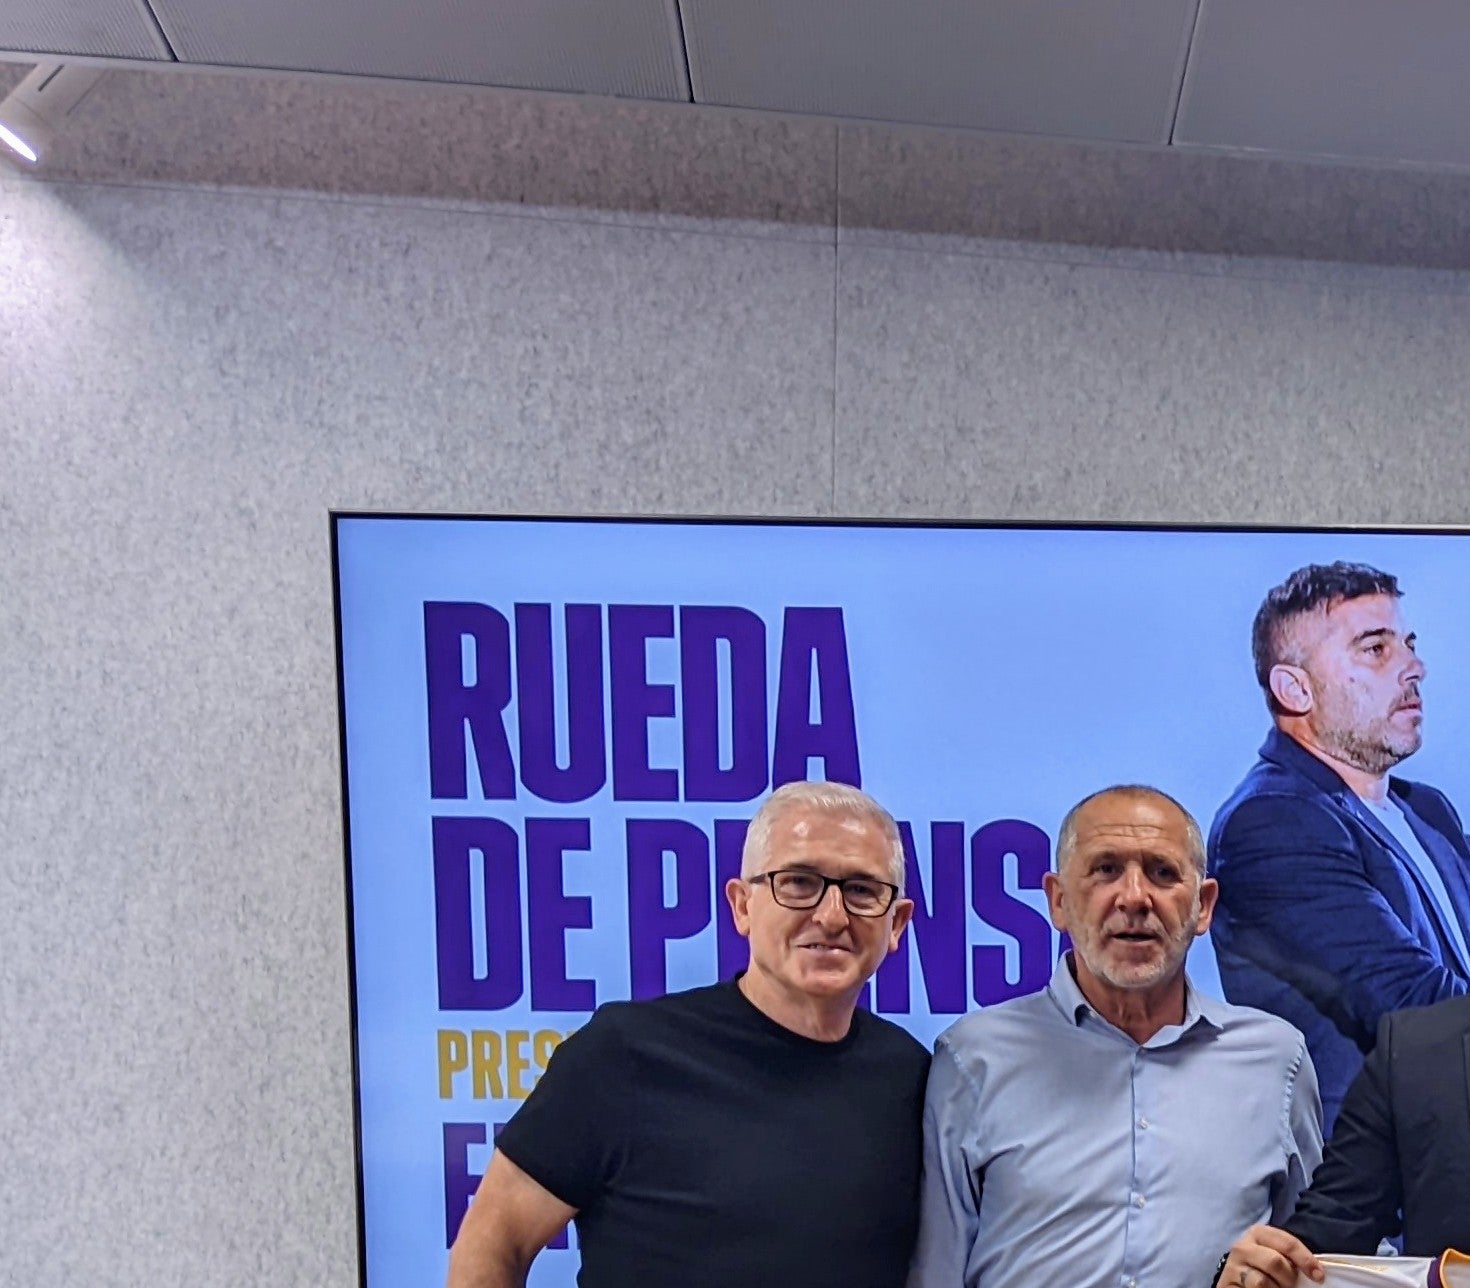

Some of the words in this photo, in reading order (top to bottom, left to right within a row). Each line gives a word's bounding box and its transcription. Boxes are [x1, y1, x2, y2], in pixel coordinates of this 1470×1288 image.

[423, 600, 862, 803] RUEDA
[431, 815, 596, 1012] DE
[625, 818, 1074, 1015] PNS
